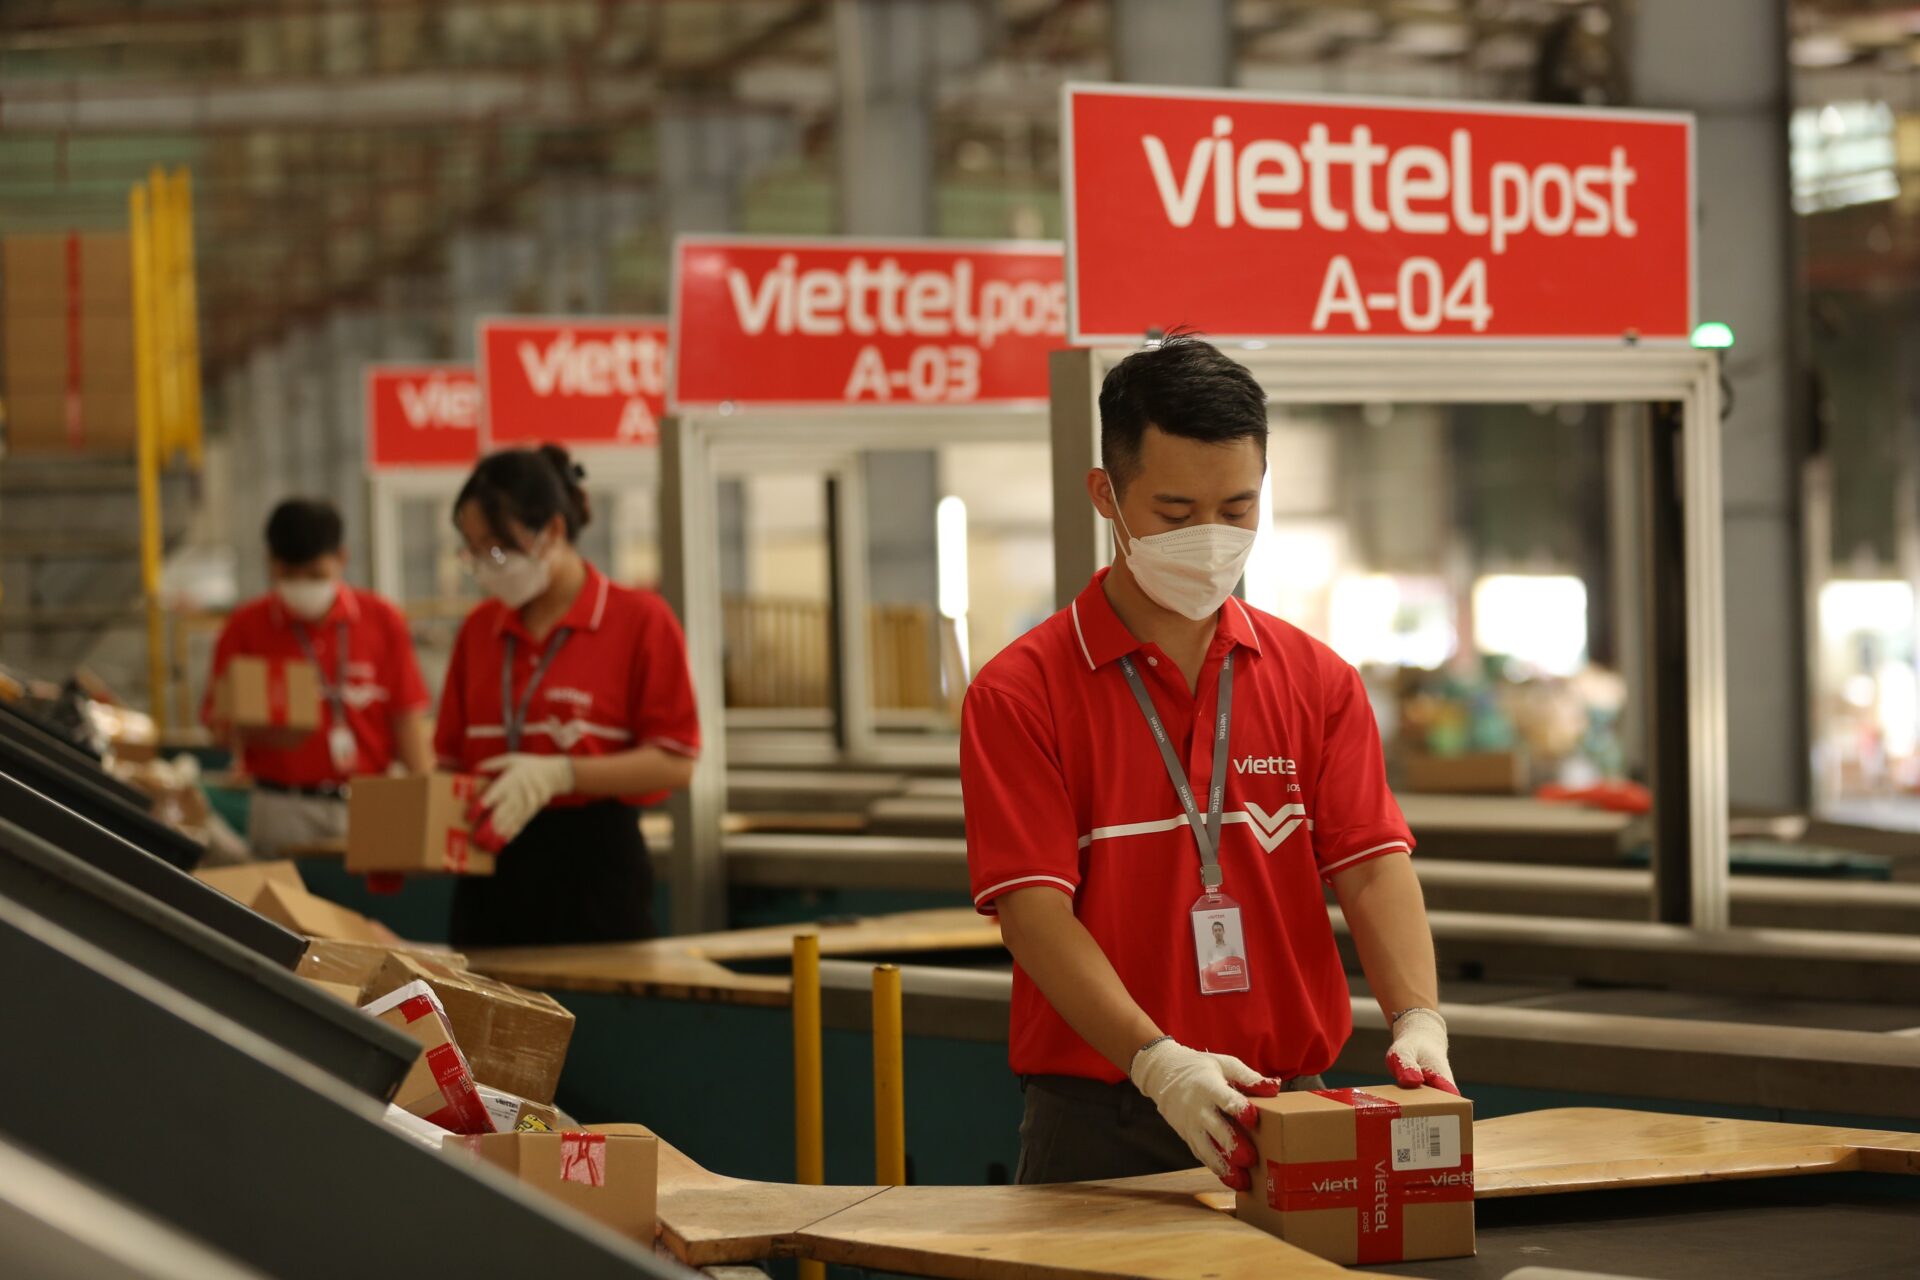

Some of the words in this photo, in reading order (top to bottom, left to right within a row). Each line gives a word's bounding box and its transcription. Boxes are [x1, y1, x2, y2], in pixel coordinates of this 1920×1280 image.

[1311, 255, 1493, 332] A-04
[844, 345, 981, 400] A-03
[1361, 1211, 1370, 1234] post
[1374, 1159, 1390, 1234] viettel
